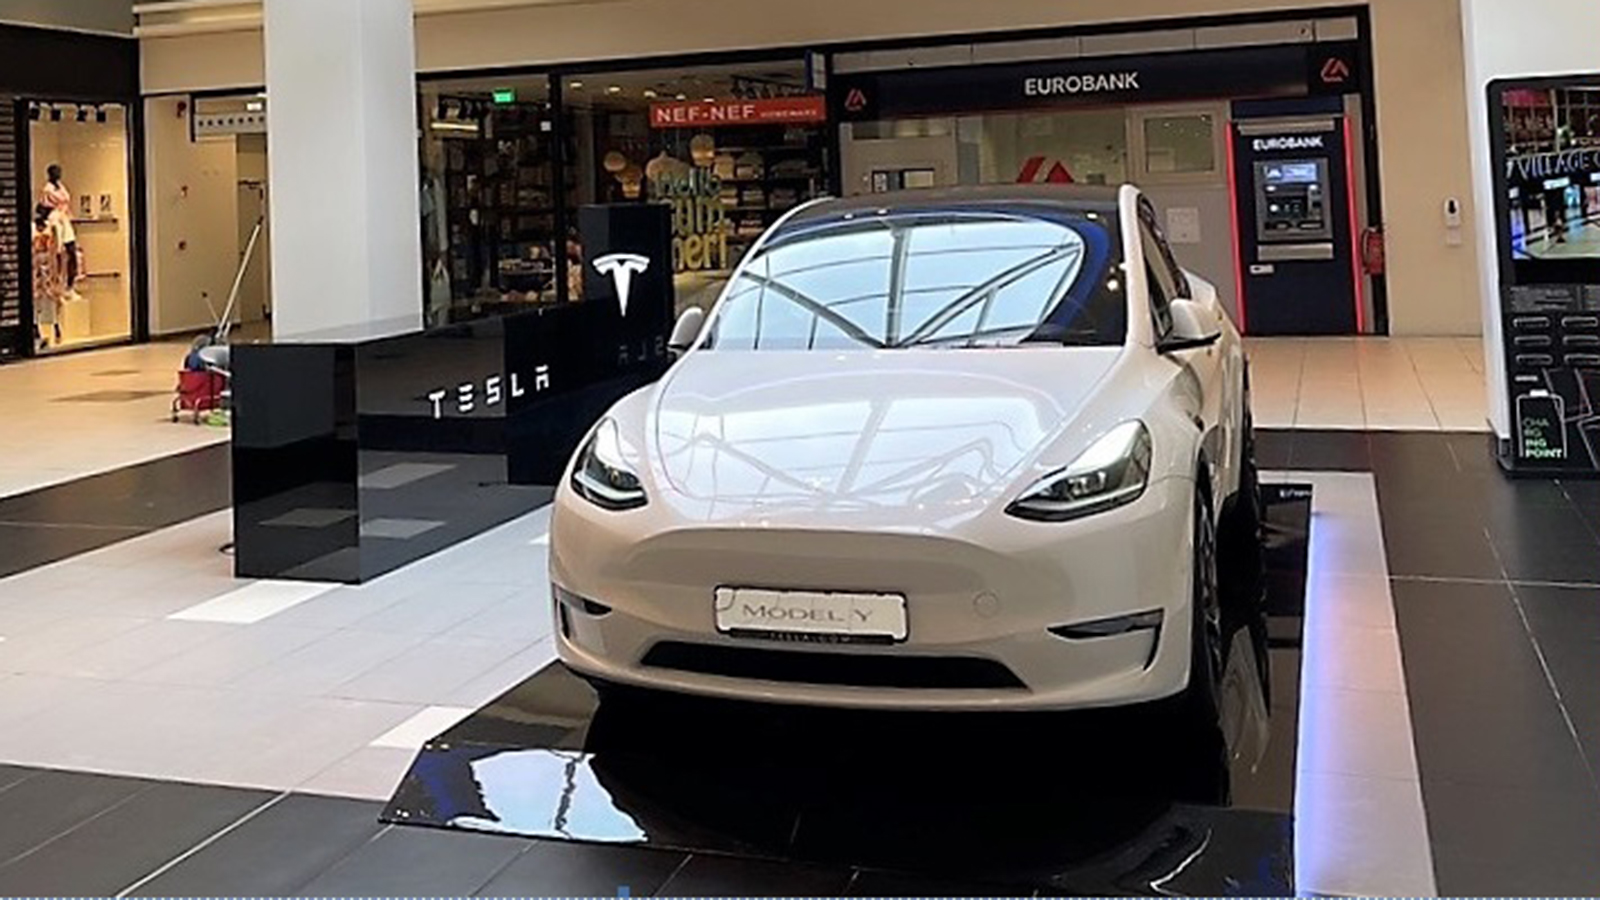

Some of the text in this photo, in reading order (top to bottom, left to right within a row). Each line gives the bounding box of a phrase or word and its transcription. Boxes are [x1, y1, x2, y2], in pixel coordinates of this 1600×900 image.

[1024, 71, 1139, 96] EUROBANK
[1252, 135, 1324, 151] EUROBANK
[428, 364, 550, 420] TESLA
[1525, 438, 1548, 448] ING
[1525, 448, 1563, 459] POINT
[742, 604, 873, 623] MODEL Y
